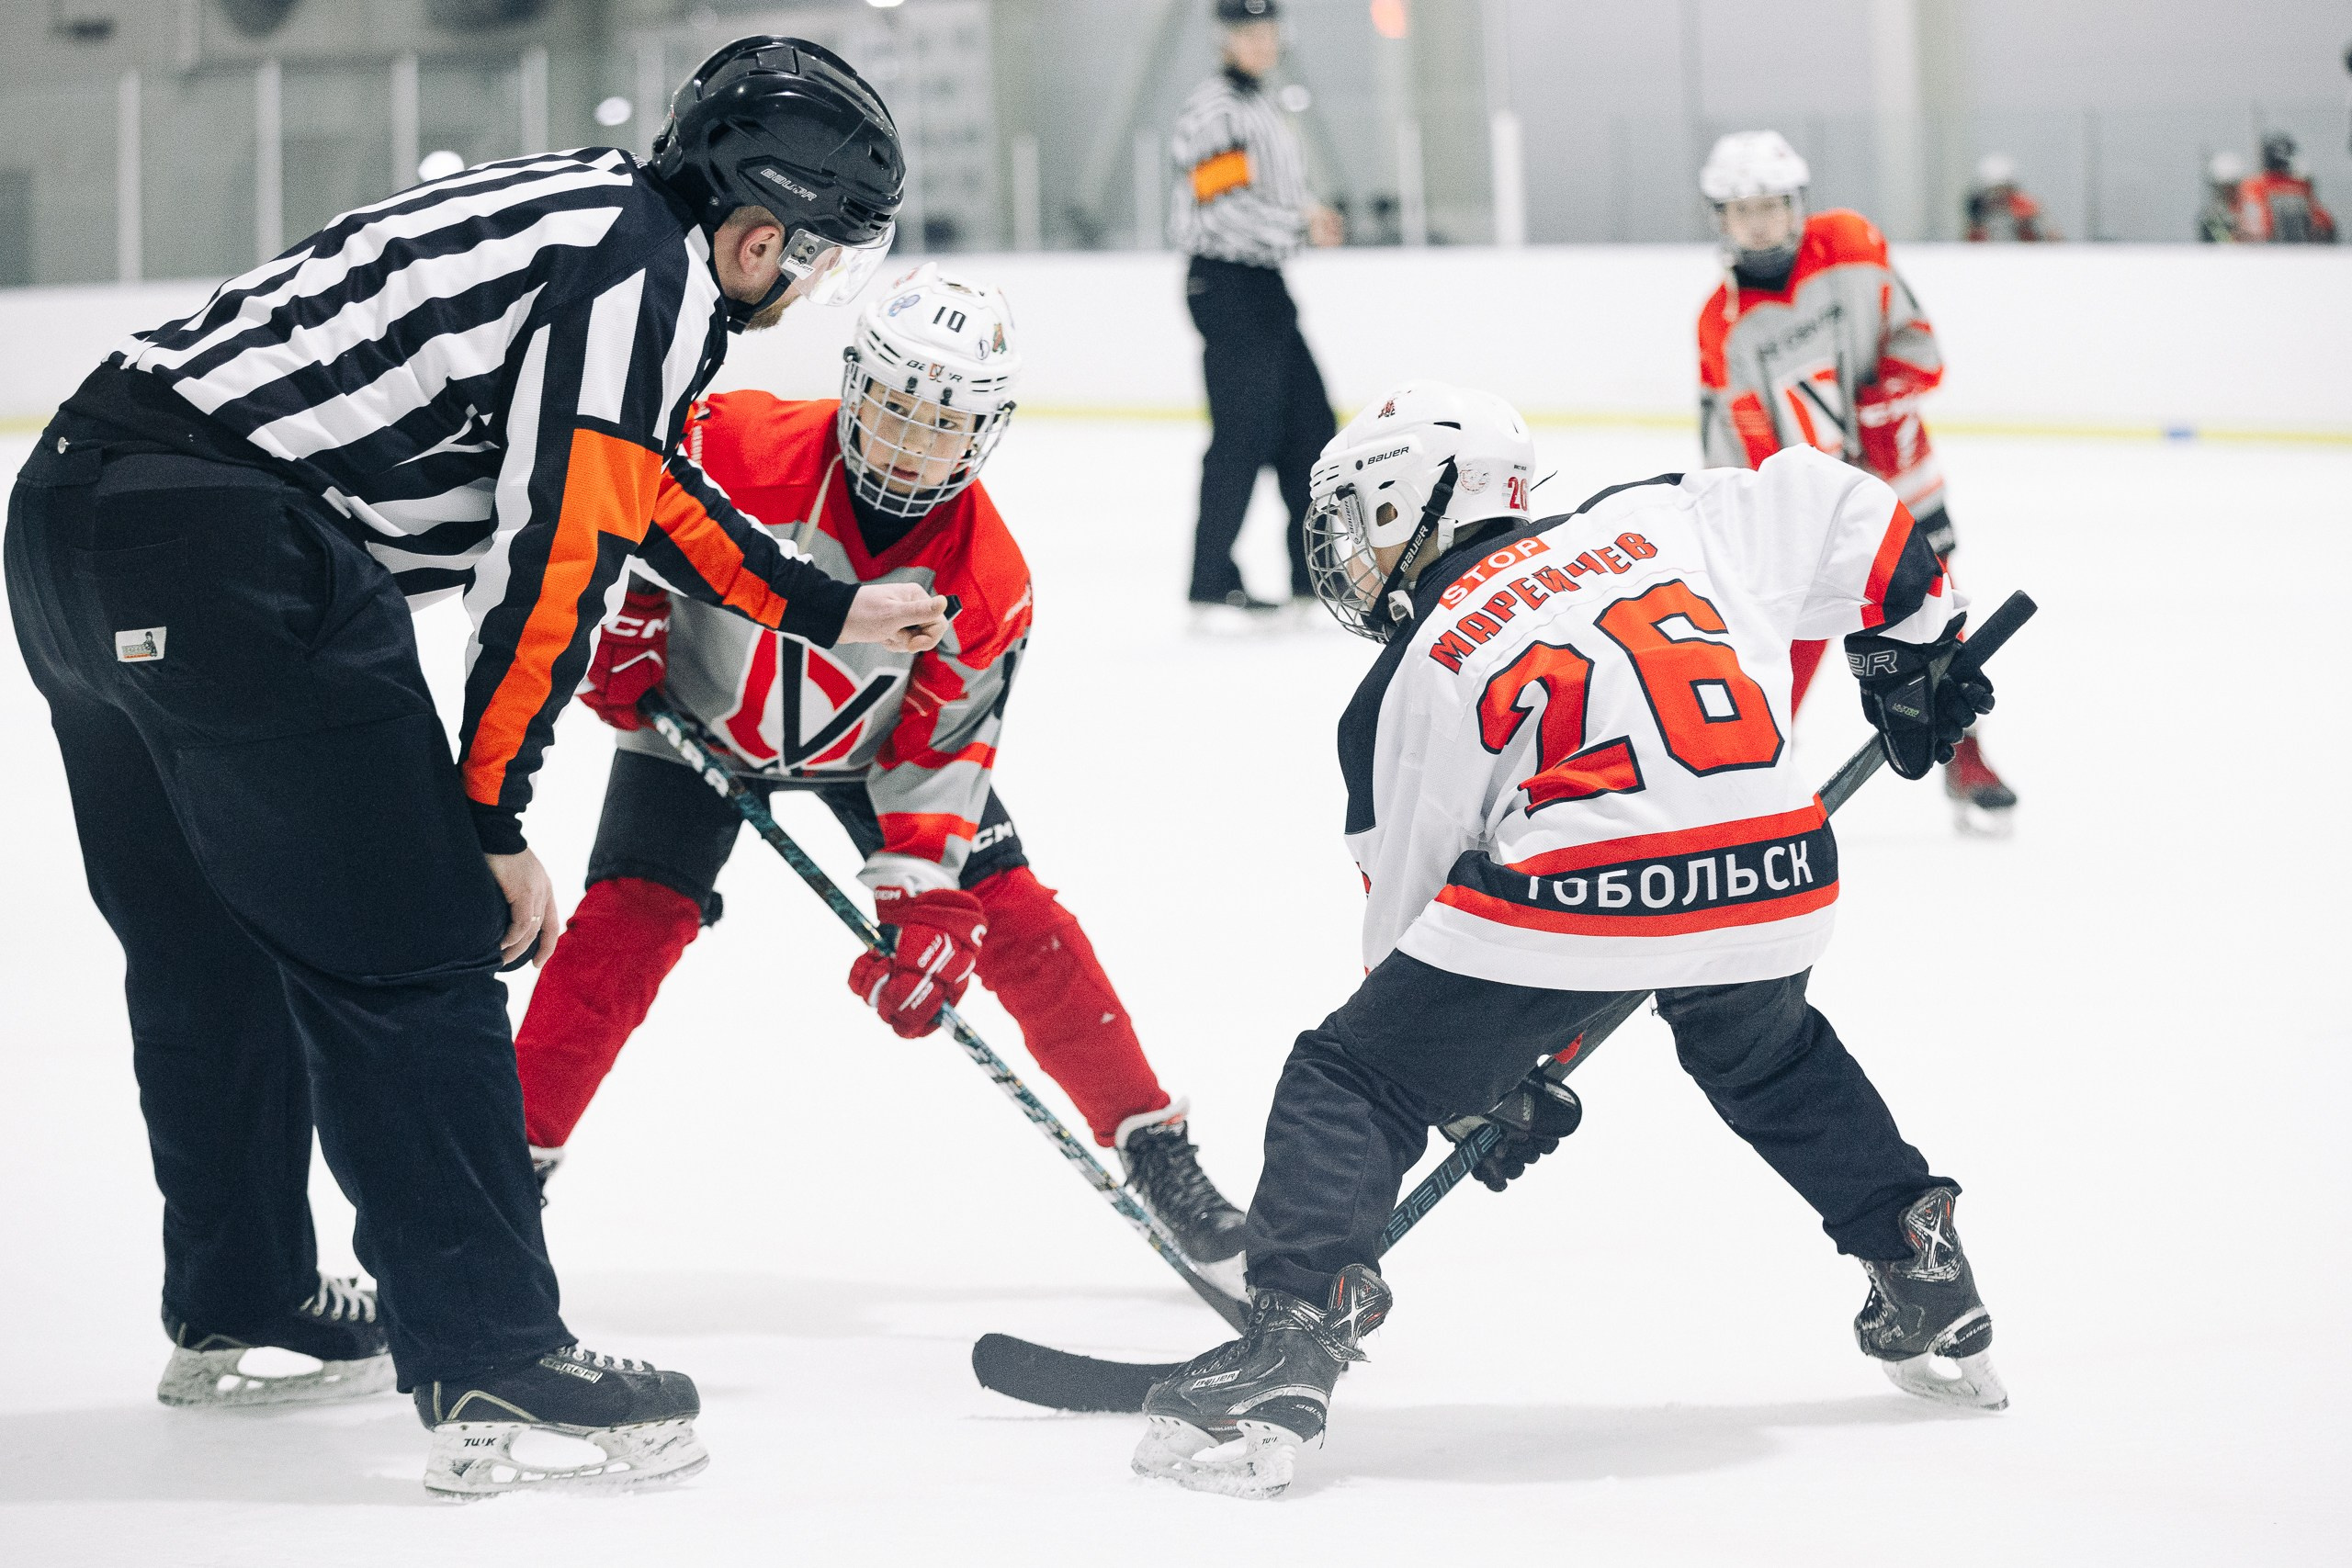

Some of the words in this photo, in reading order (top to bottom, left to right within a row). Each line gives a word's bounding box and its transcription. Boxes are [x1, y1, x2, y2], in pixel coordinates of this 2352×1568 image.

[760, 168, 818, 201] BAUER
[933, 306, 967, 333] 10
[1367, 446, 1410, 466] BAUER
[1399, 525, 1429, 573] BAUER
[1442, 538, 1540, 605] STOP
[1476, 578, 1785, 820] 26
[971, 820, 1014, 853] CM
[464, 1437, 497, 1448] TUK
